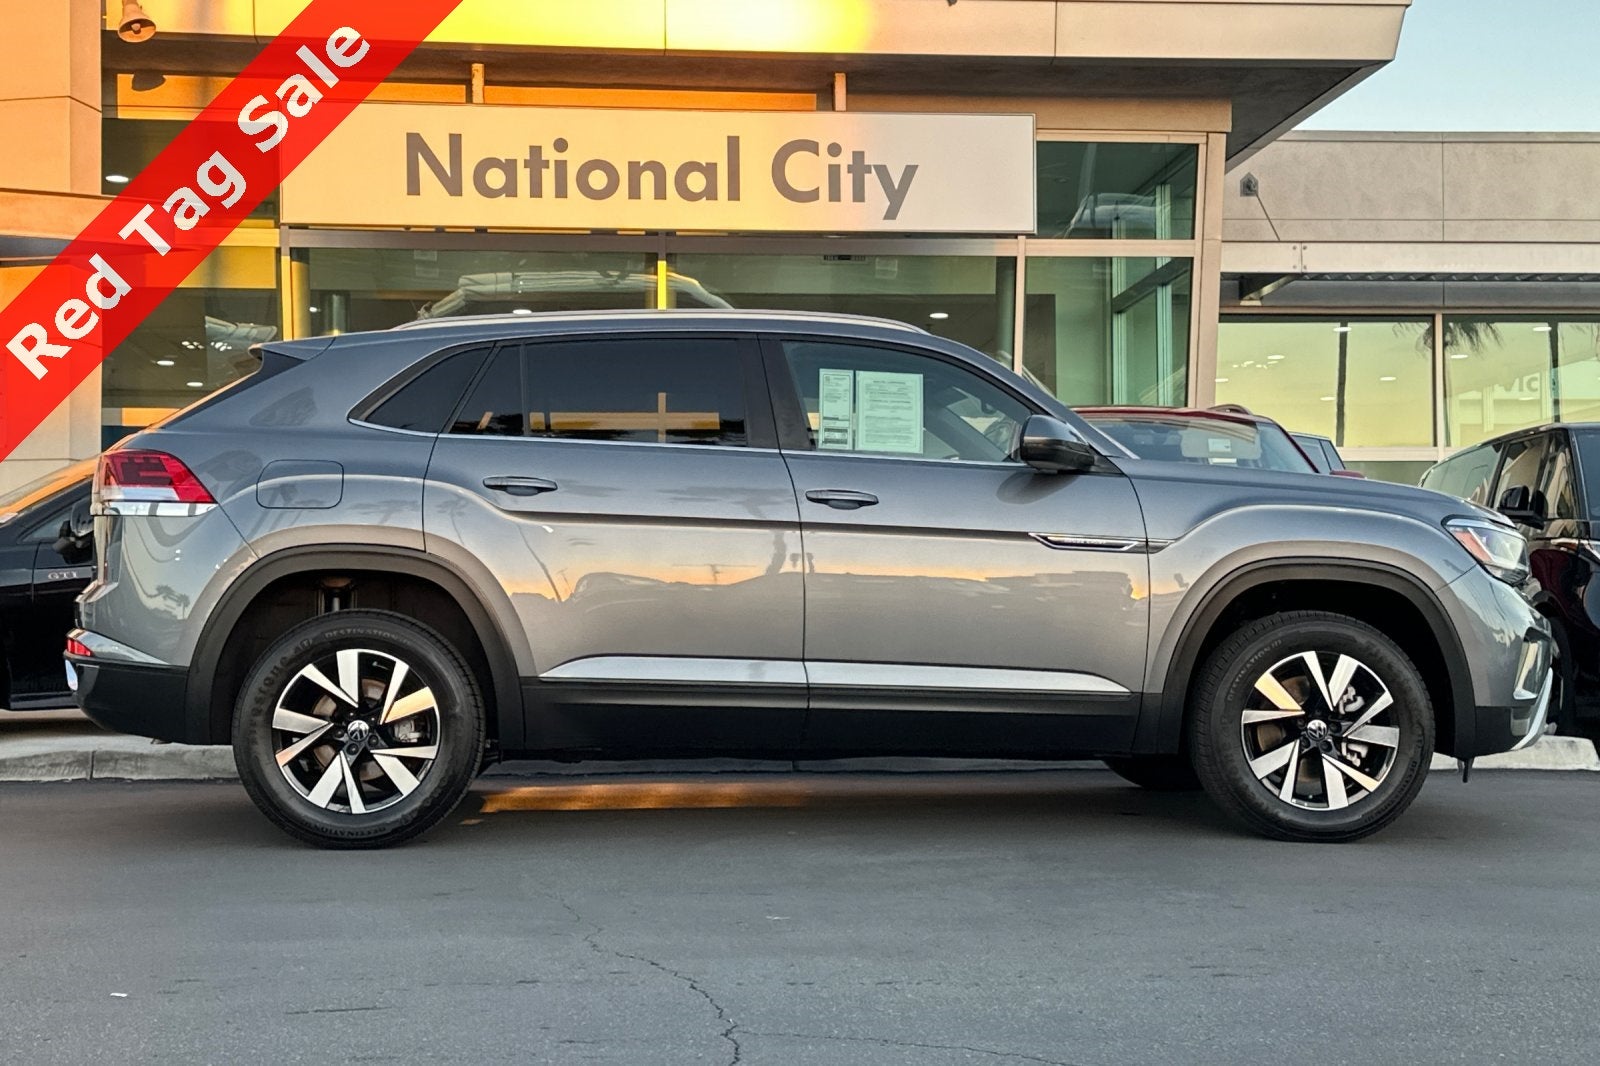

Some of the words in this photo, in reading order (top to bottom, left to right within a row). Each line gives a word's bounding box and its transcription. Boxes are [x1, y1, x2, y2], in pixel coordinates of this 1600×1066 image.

[405, 133, 742, 202] National
[771, 139, 920, 221] City
[48, 570, 78, 580] GTI
